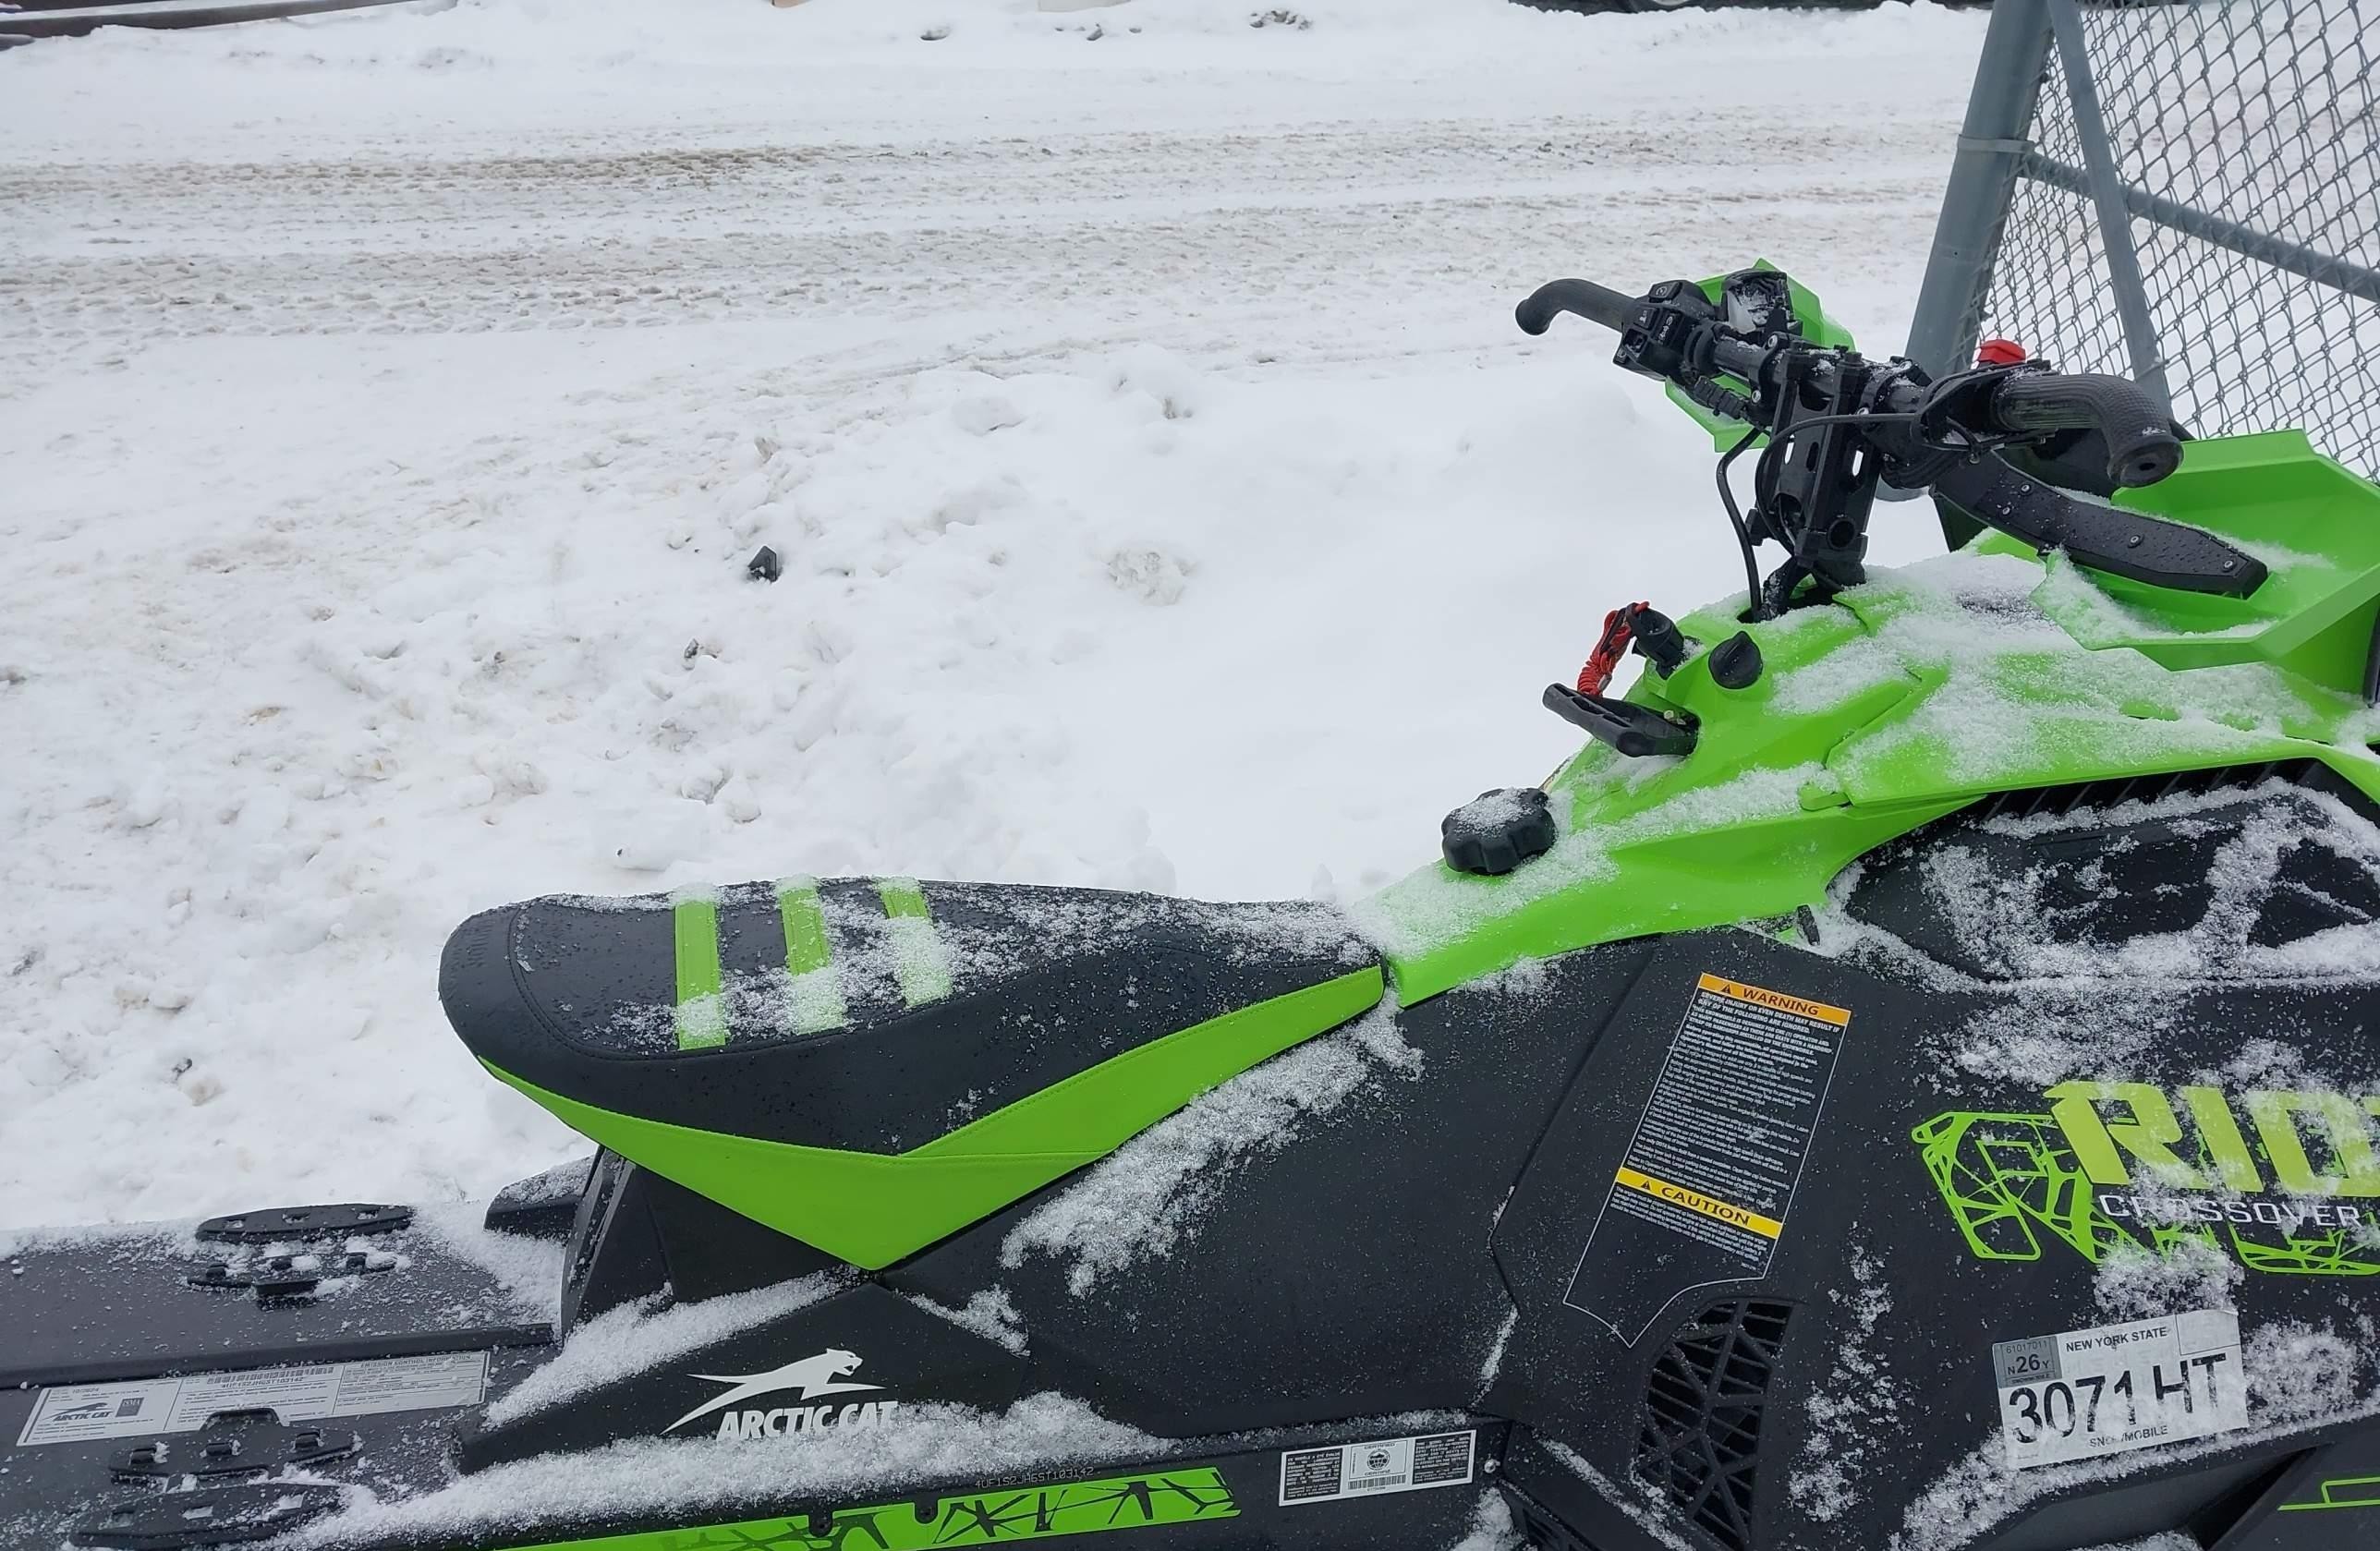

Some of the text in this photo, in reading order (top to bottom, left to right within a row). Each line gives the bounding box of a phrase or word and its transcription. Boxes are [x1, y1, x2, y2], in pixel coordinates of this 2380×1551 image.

[1743, 988, 1820, 1016] WARNING
[1661, 1186, 1750, 1225] CAUTION
[2066, 1326, 2168, 1353] NEW YORK STATE
[2009, 1352, 2227, 1444] 3071 HT
[53, 1411, 114, 1423] ARCTIC CAT
[715, 1400, 899, 1441] ARCTIC CAT
